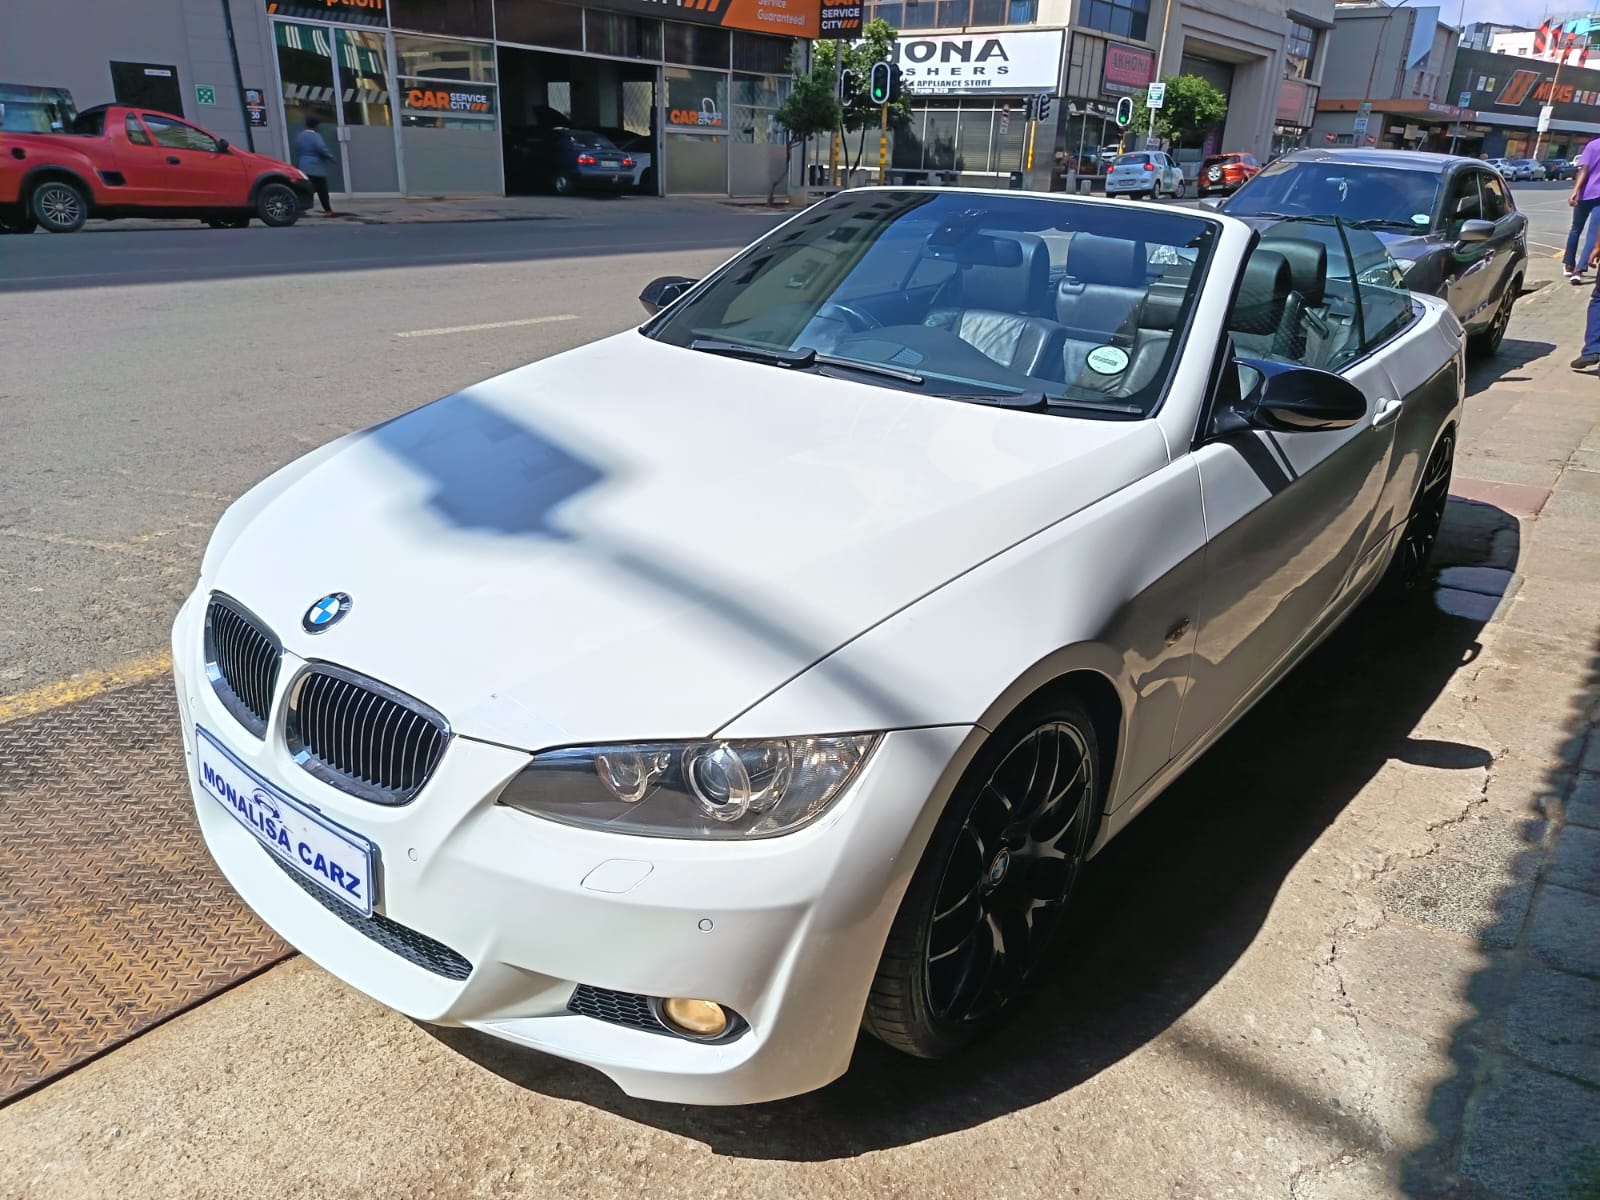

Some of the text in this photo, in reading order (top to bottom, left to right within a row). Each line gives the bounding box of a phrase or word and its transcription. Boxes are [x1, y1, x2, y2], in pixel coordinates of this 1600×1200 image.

[821, 8, 860, 18] SERVICE
[821, 20, 842, 30] CITY
[408, 88, 450, 110] CAR
[450, 93, 487, 104] SERVICE
[450, 101, 472, 110] CITY
[671, 109, 698, 125] CAR
[203, 761, 292, 852] MONALISA
[297, 842, 362, 900] CARZ
